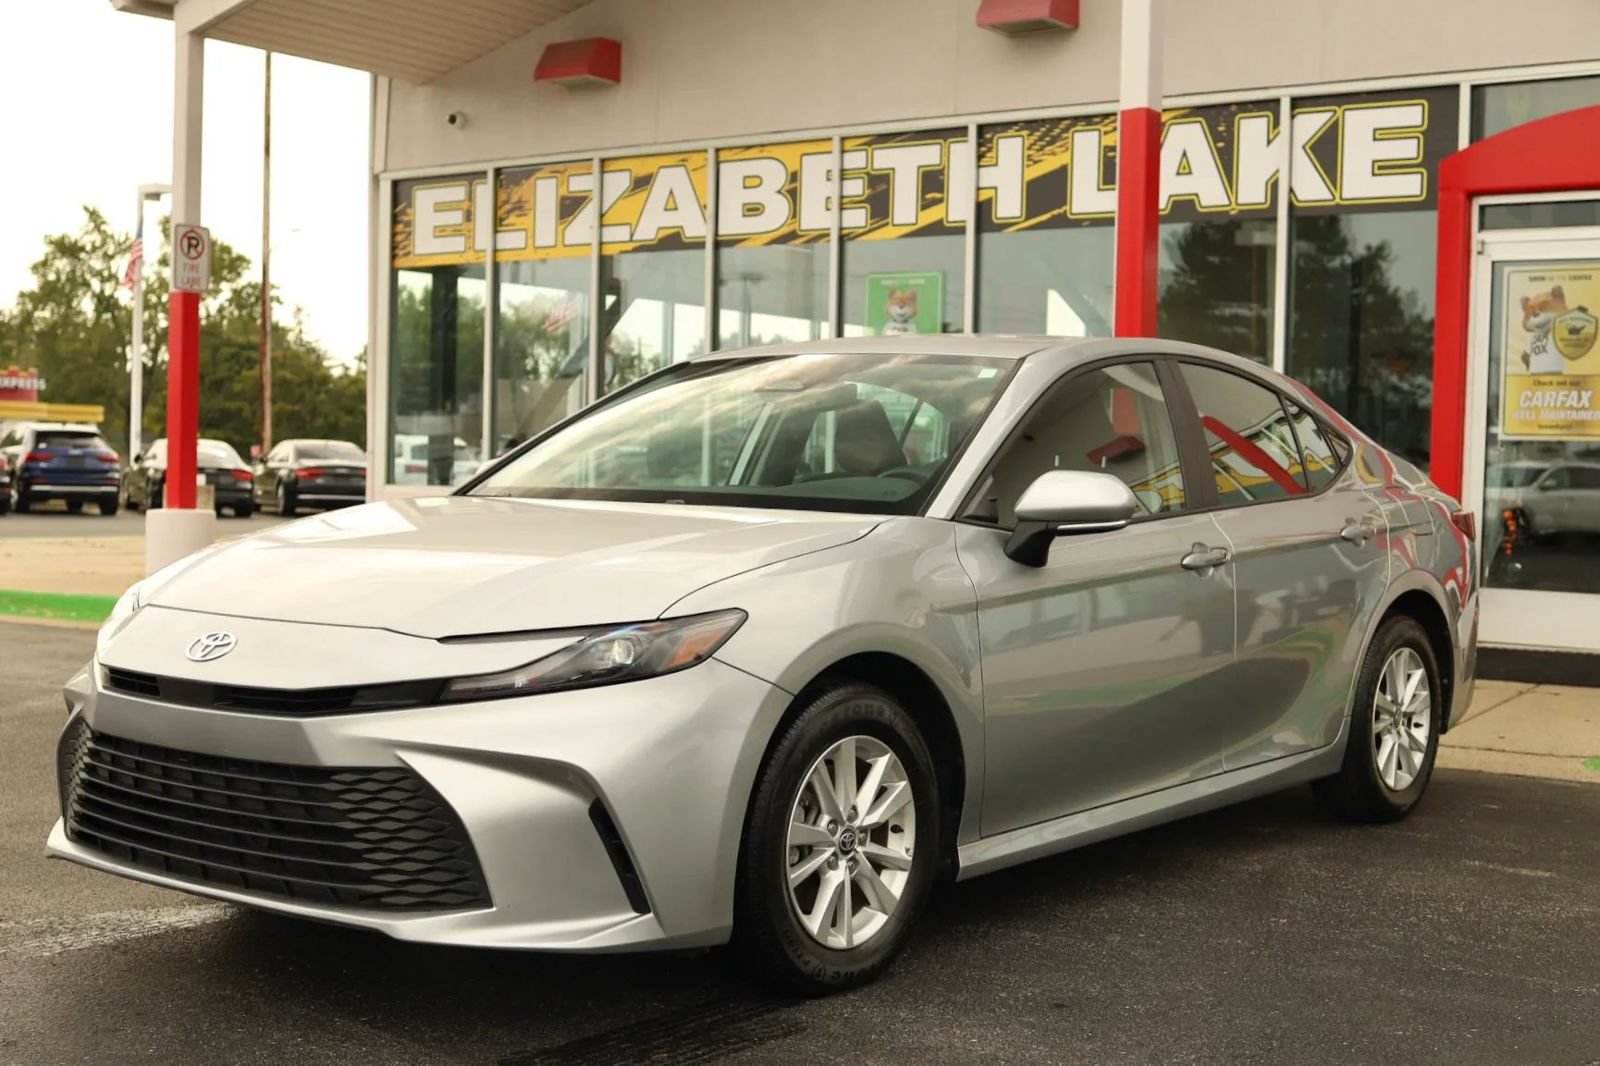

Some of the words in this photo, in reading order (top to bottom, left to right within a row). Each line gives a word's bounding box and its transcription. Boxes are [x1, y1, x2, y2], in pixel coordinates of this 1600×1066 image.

[412, 131, 1027, 256] ELIZABETH
[1068, 99, 1428, 219] LAKE
[1520, 390, 1592, 408] CARFAX
